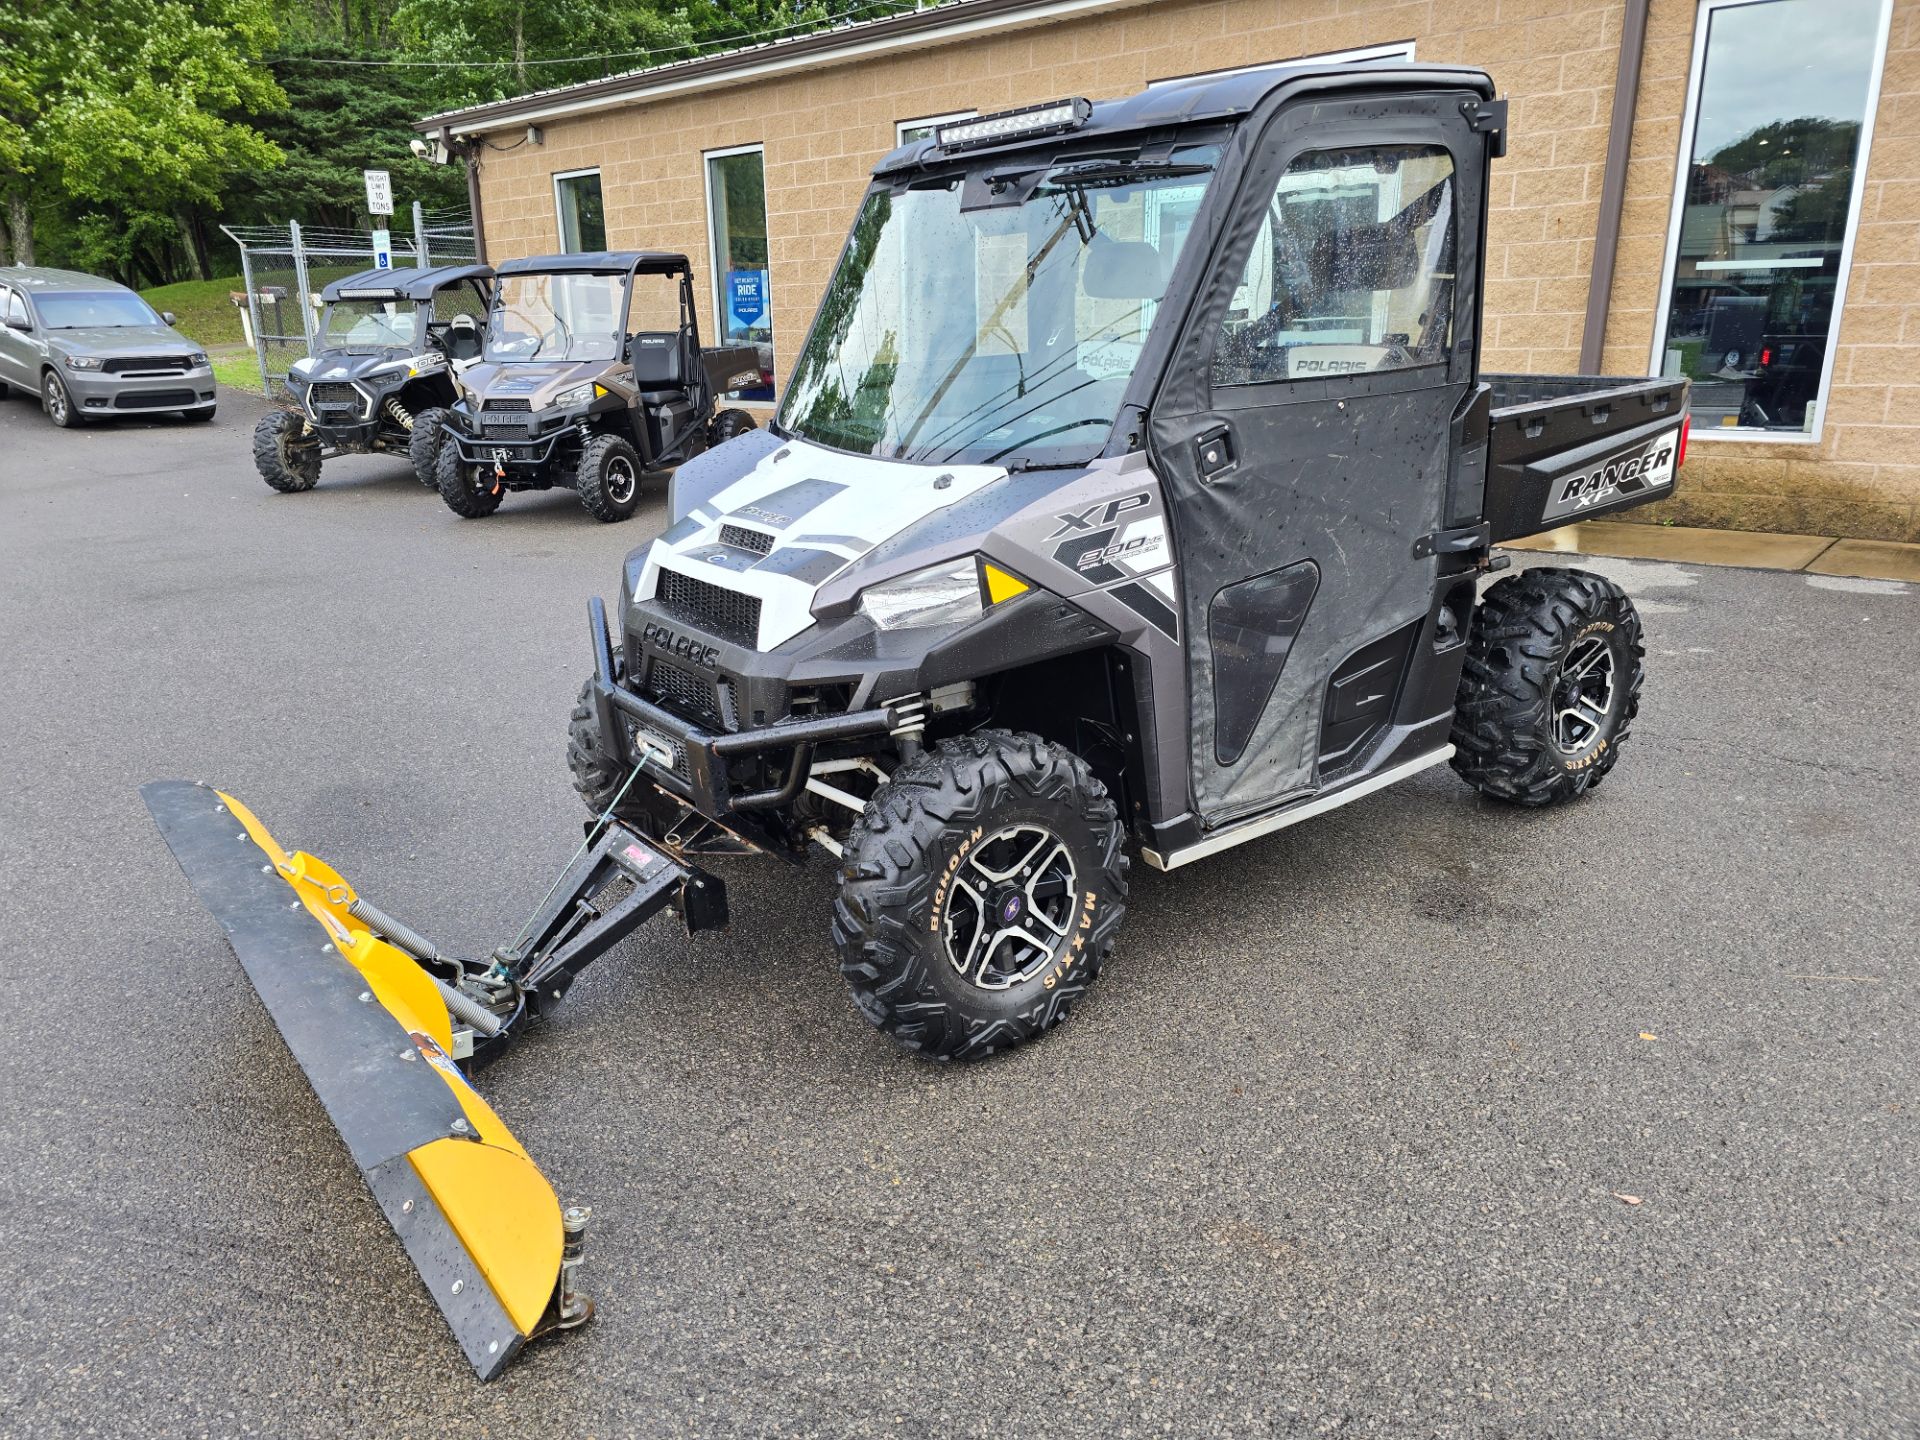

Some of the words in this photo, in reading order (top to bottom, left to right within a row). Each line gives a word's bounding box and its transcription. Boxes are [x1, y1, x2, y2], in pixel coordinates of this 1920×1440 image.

[372, 202, 390, 211] TONS
[737, 284, 757, 296] RIDE
[414, 354, 445, 369] 1000
[1082, 355, 1131, 369] POLARIS
[1296, 360, 1367, 373] POLARIS
[1558, 447, 1672, 504] RANGER
[1573, 487, 1614, 510] XP
[1040, 491, 1152, 542] XP
[1077, 536, 1147, 567] 900
[643, 622, 721, 669] POLARIS
[1566, 738, 1608, 770] MAXXIS
[930, 826, 983, 931] BIGHORN
[1043, 891, 1096, 989] MAXXIS
